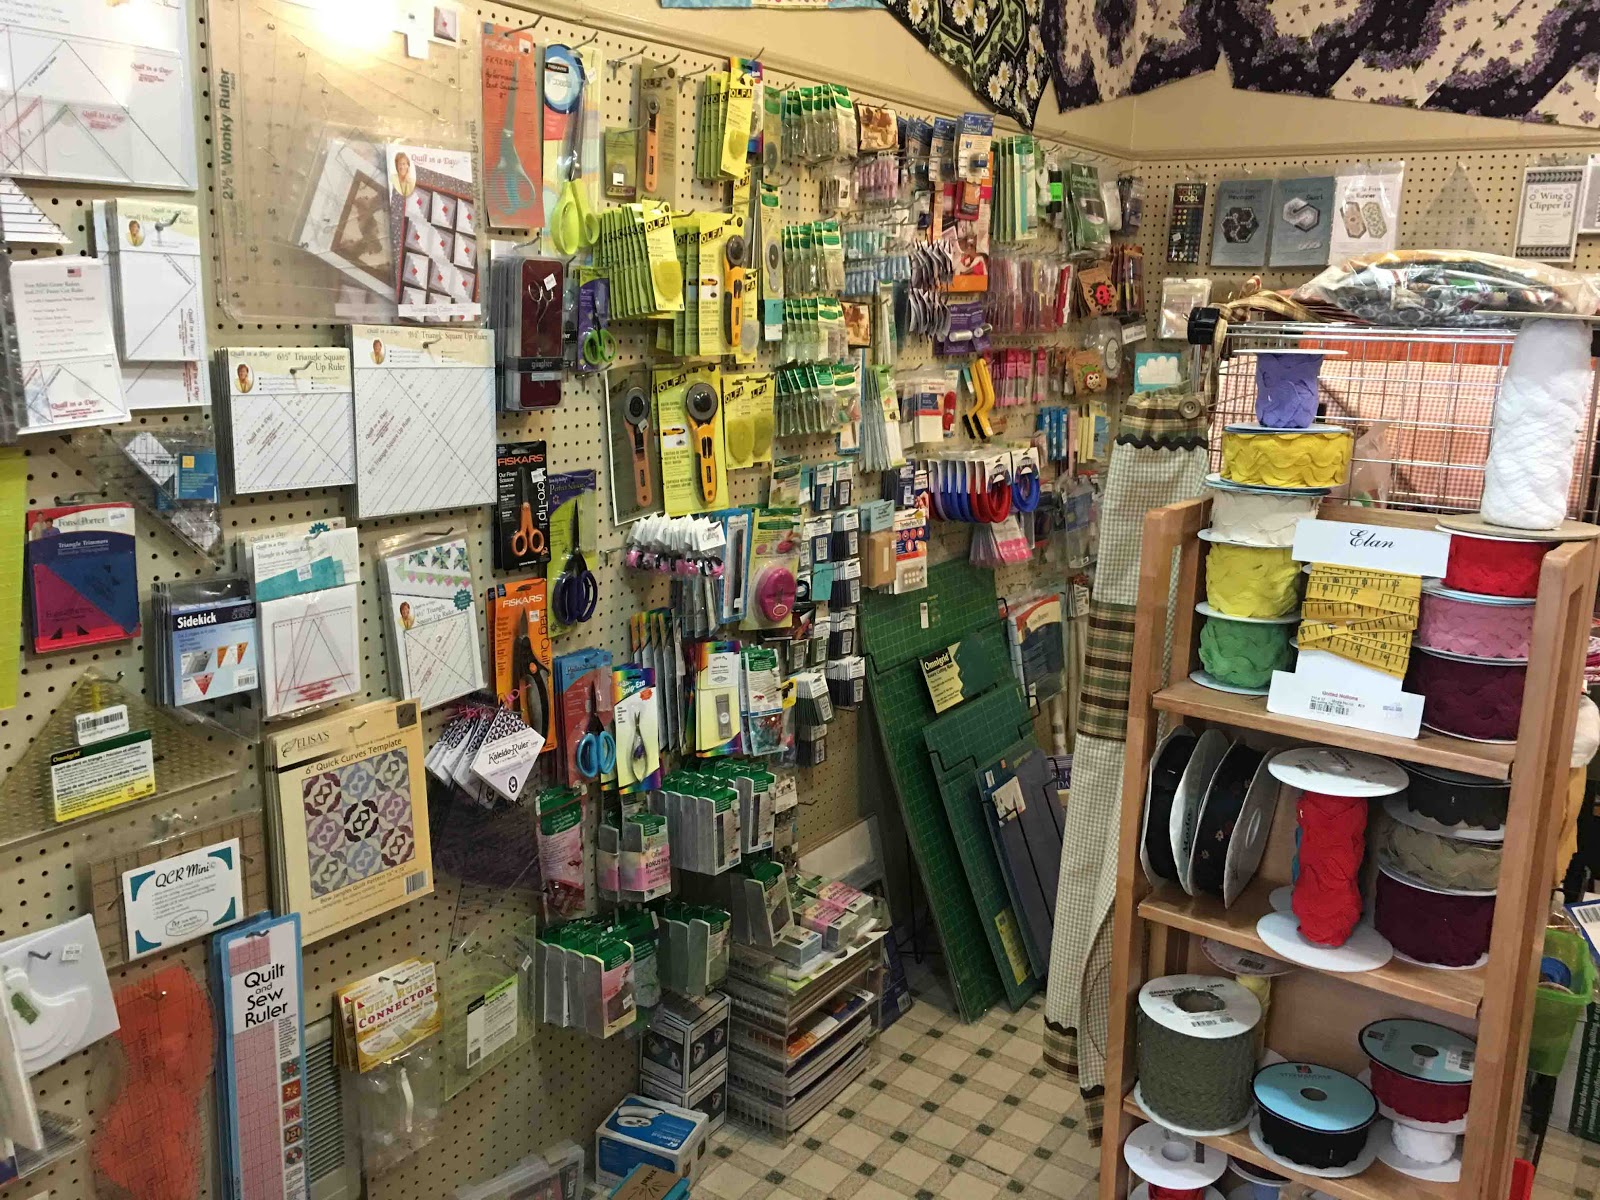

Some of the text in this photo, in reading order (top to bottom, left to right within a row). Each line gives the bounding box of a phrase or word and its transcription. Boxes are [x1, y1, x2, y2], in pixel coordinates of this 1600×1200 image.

[219, 68, 232, 110] Ruler
[730, 88, 752, 98] OLFA
[220, 116, 234, 166] Wonky
[411, 154, 427, 162] Quilt
[443, 157, 458, 167] Day
[1540, 192, 1563, 202] Wing
[1529, 201, 1561, 211] Clipper
[646, 216, 670, 232] OLFA
[700, 227, 724, 244] OLFA
[444, 332, 463, 341] Square
[464, 333, 473, 341] Up
[276, 352, 346, 364] 6½" Triangle Square
[315, 362, 346, 373] Up Ruler
[658, 374, 687, 392] OLFA
[725, 387, 745, 403] OLFA
[51, 401, 67, 412] Quilt
[84, 399, 99, 408] Day
[498, 454, 545, 466] FISKARS
[58, 541, 82, 549] Triangle
[1349, 528, 1395, 549] Elan
[257, 551, 275, 560] Triangle
[502, 594, 543, 608] FISKARS
[177, 612, 217, 629] Sidekick
[541, 638, 550, 666] Quilt
[924, 653, 950, 671] Omnigrid
[1322, 690, 1339, 698] United
[297, 730, 330, 748] ELISA'S
[53, 751, 81, 762] Omnigrid
[305, 738, 402, 774] 6" Quick Curves Template
[488, 741, 529, 764] Kaleido-Ruler
[645, 858, 661, 869] BONUS
[155, 862, 210, 888] QCR Mini
[244, 962, 285, 989] Quilt
[255, 982, 273, 995] and
[247, 988, 284, 1012] Sew
[358, 985, 433, 1029] CONNECTOR
[244, 1003, 288, 1028] Ruler
[1579, 1085, 1589, 1105] surface
